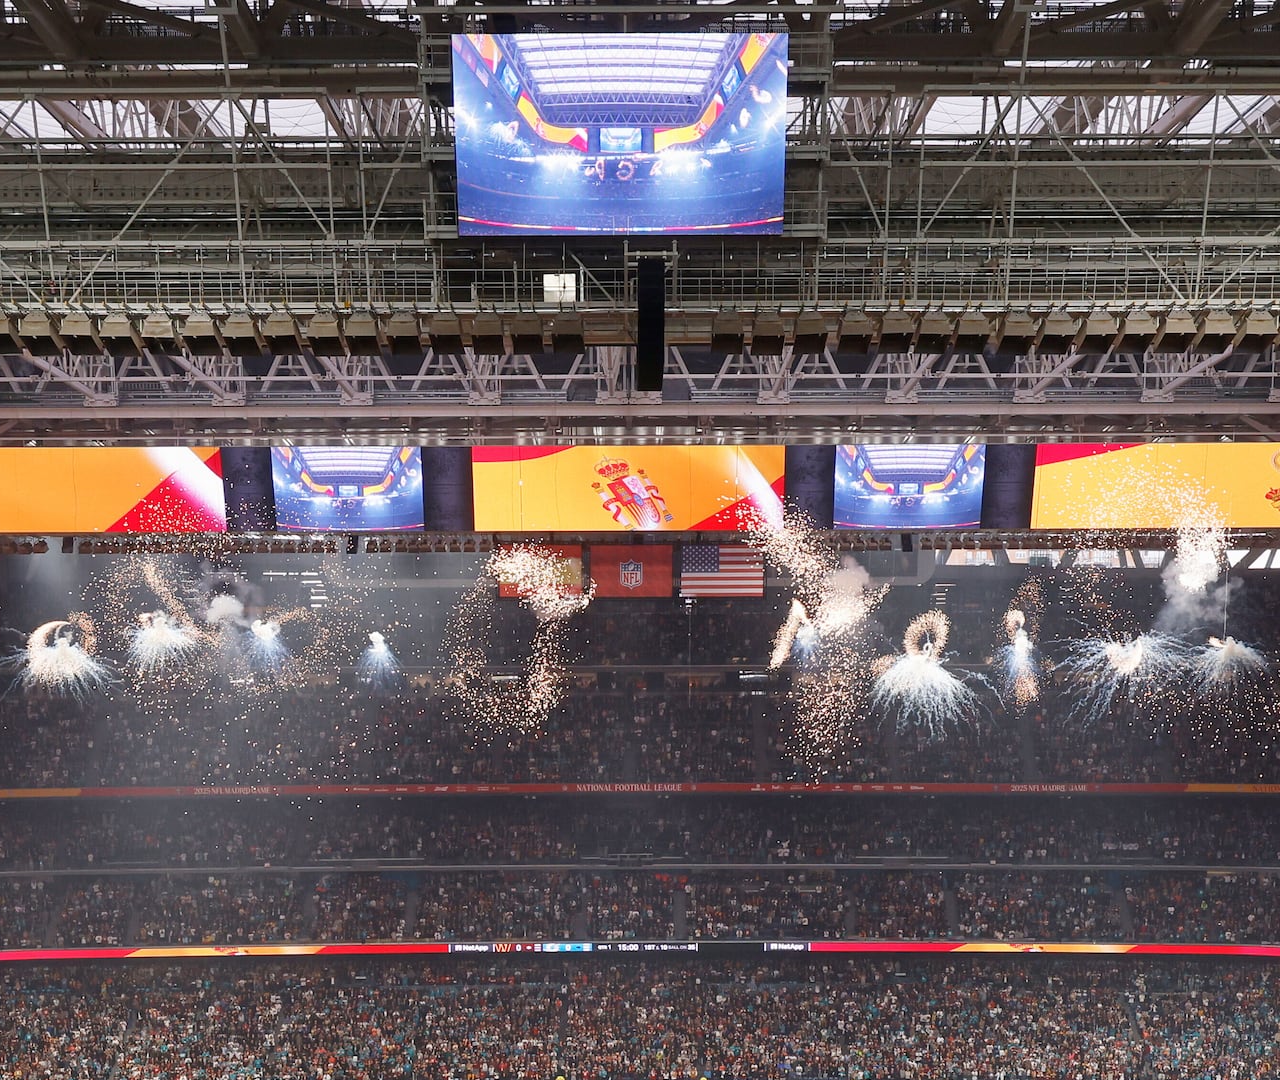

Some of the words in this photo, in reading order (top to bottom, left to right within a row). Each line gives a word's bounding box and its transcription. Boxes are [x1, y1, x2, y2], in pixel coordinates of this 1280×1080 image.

[623, 572, 641, 583] NFL
[576, 784, 613, 792] NATIONAL
[614, 784, 652, 792] FOOTBALL
[654, 784, 682, 792] LEAGUE
